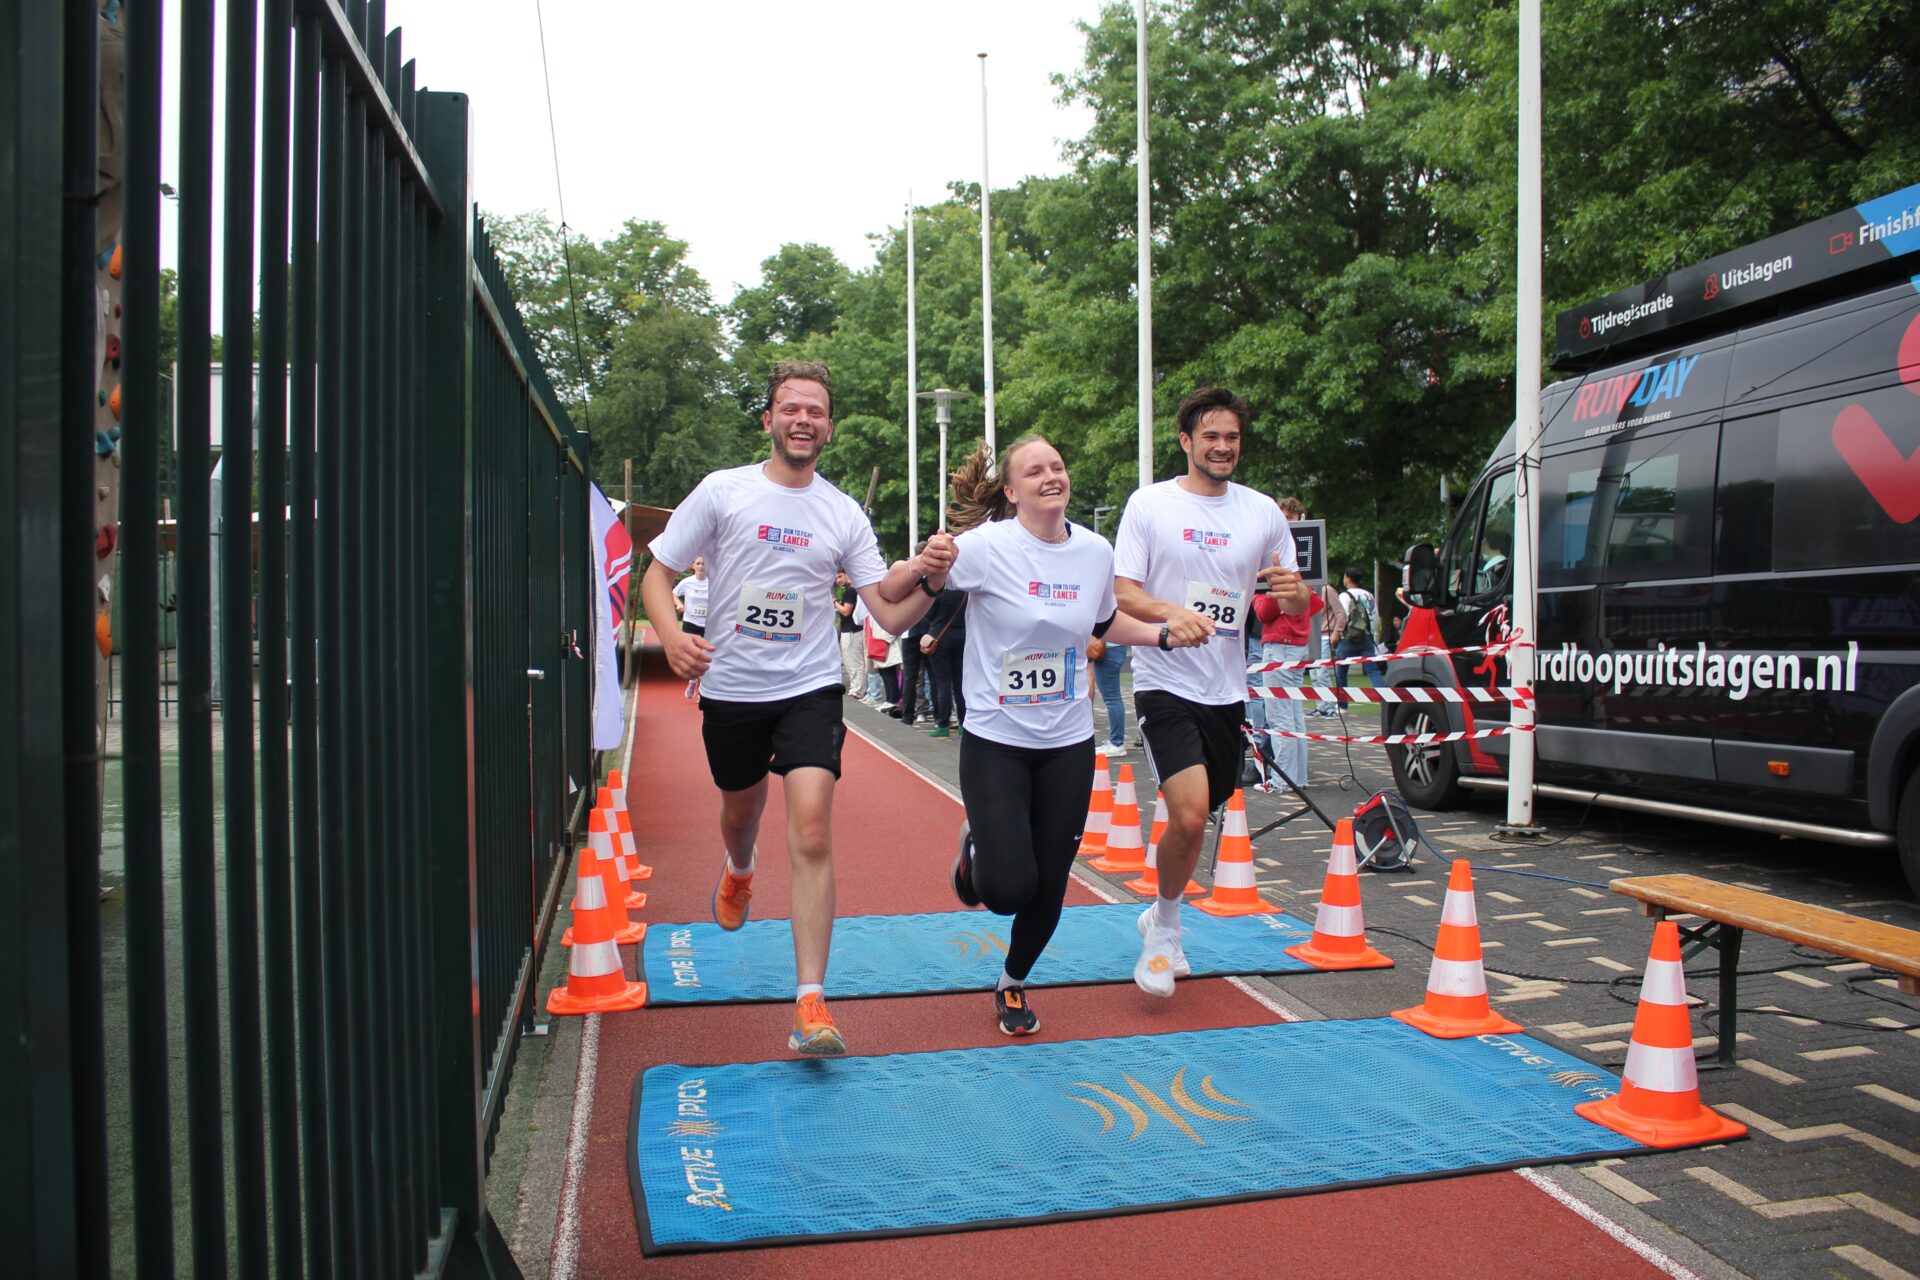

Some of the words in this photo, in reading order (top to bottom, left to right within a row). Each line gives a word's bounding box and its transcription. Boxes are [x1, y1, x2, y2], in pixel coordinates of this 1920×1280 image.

[1722, 255, 1793, 291] Uitslagen
[1591, 292, 1674, 334] Tijdregistratie
[1600, 421, 1626, 433] RUNNERS
[1627, 418, 1643, 429] VOOR
[1643, 410, 1672, 424] RUNNERS
[782, 534, 810, 548] CANCER
[1296, 535, 1313, 572] 3
[1052, 590, 1078, 600] CANCER
[745, 605, 795, 629] 253
[1193, 601, 1236, 625] 238
[1008, 668, 1057, 690] 319
[1477, 1034, 1555, 1065] CTIVE
[677, 1079, 708, 1117] IPICO
[681, 1146, 730, 1211] ACTIVE
